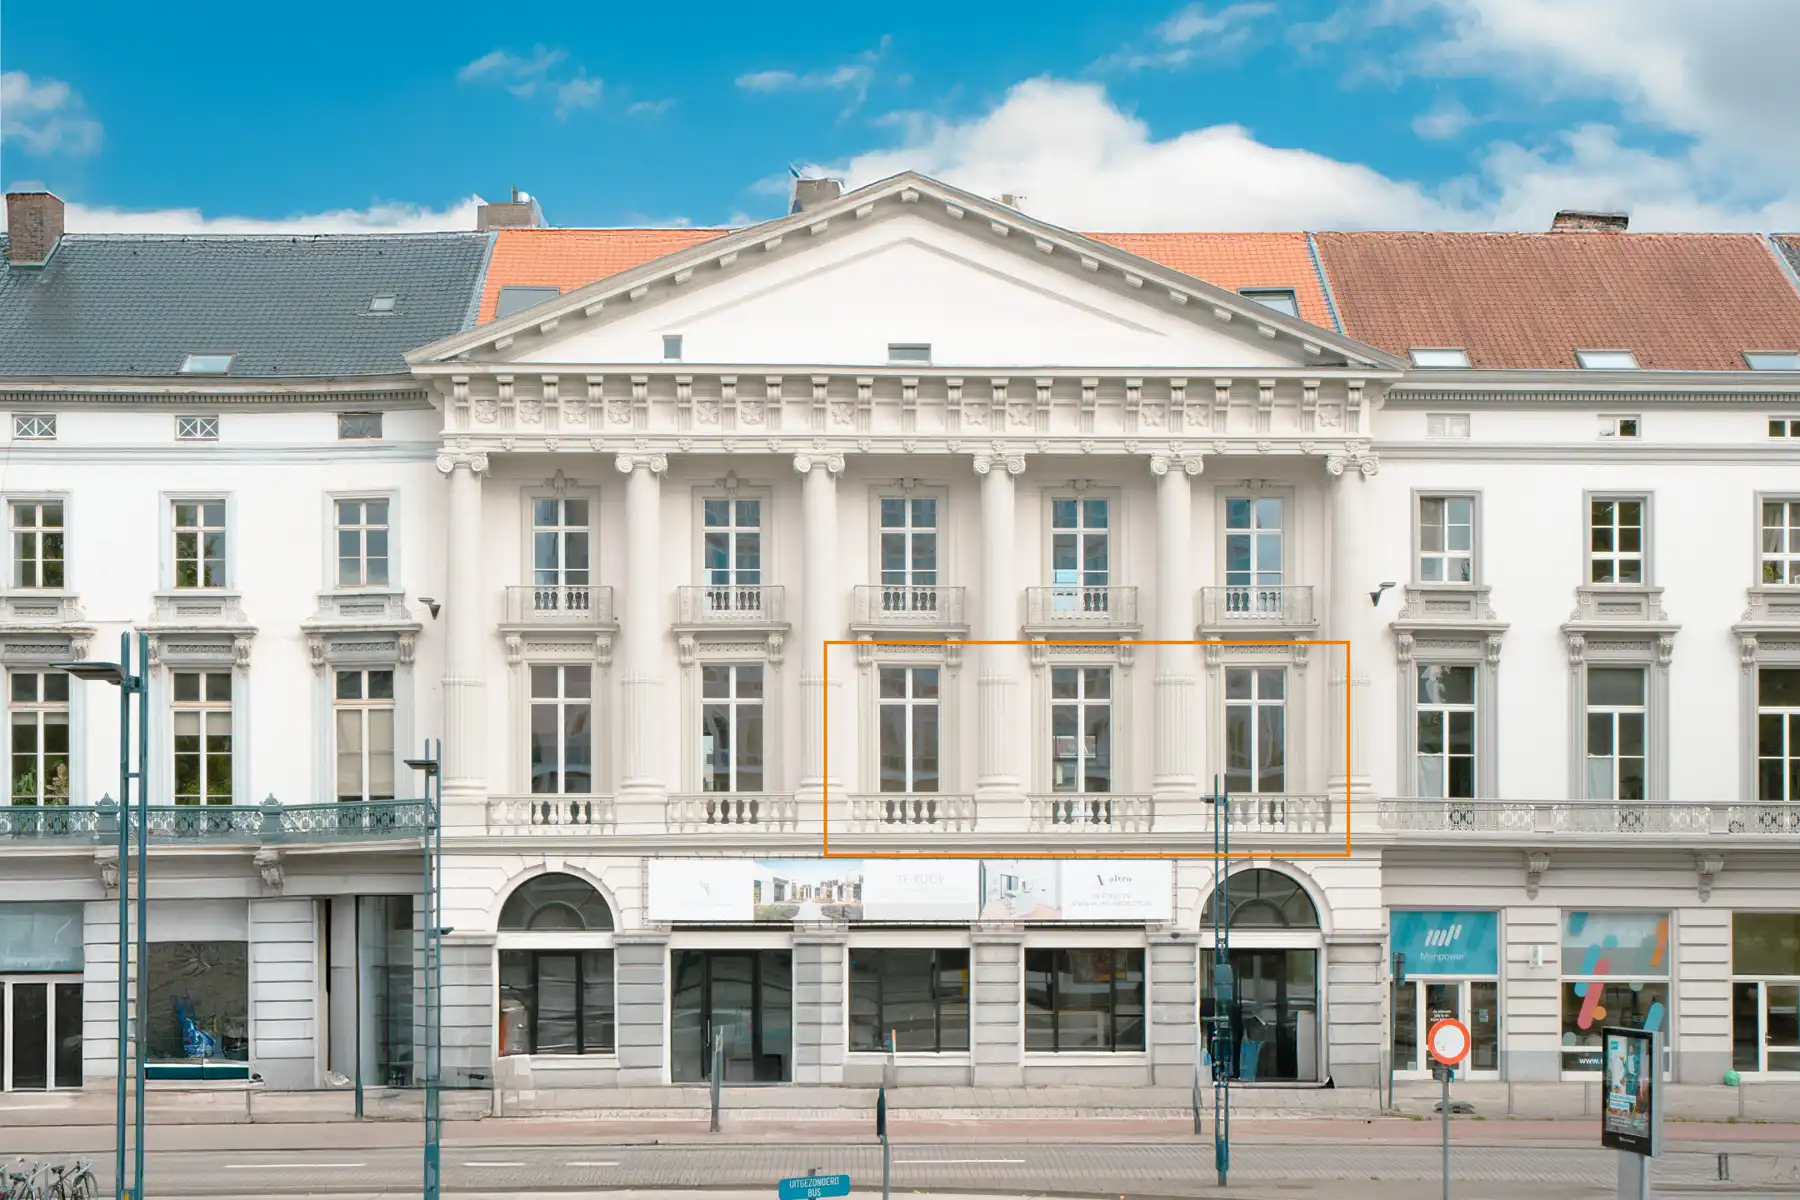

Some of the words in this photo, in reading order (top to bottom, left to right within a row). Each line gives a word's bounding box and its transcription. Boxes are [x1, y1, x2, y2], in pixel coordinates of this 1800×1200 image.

[913, 873, 945, 886] KOOP
[789, 1177, 840, 1188] UITGEZONDERD
[808, 1188, 822, 1197] BUS
